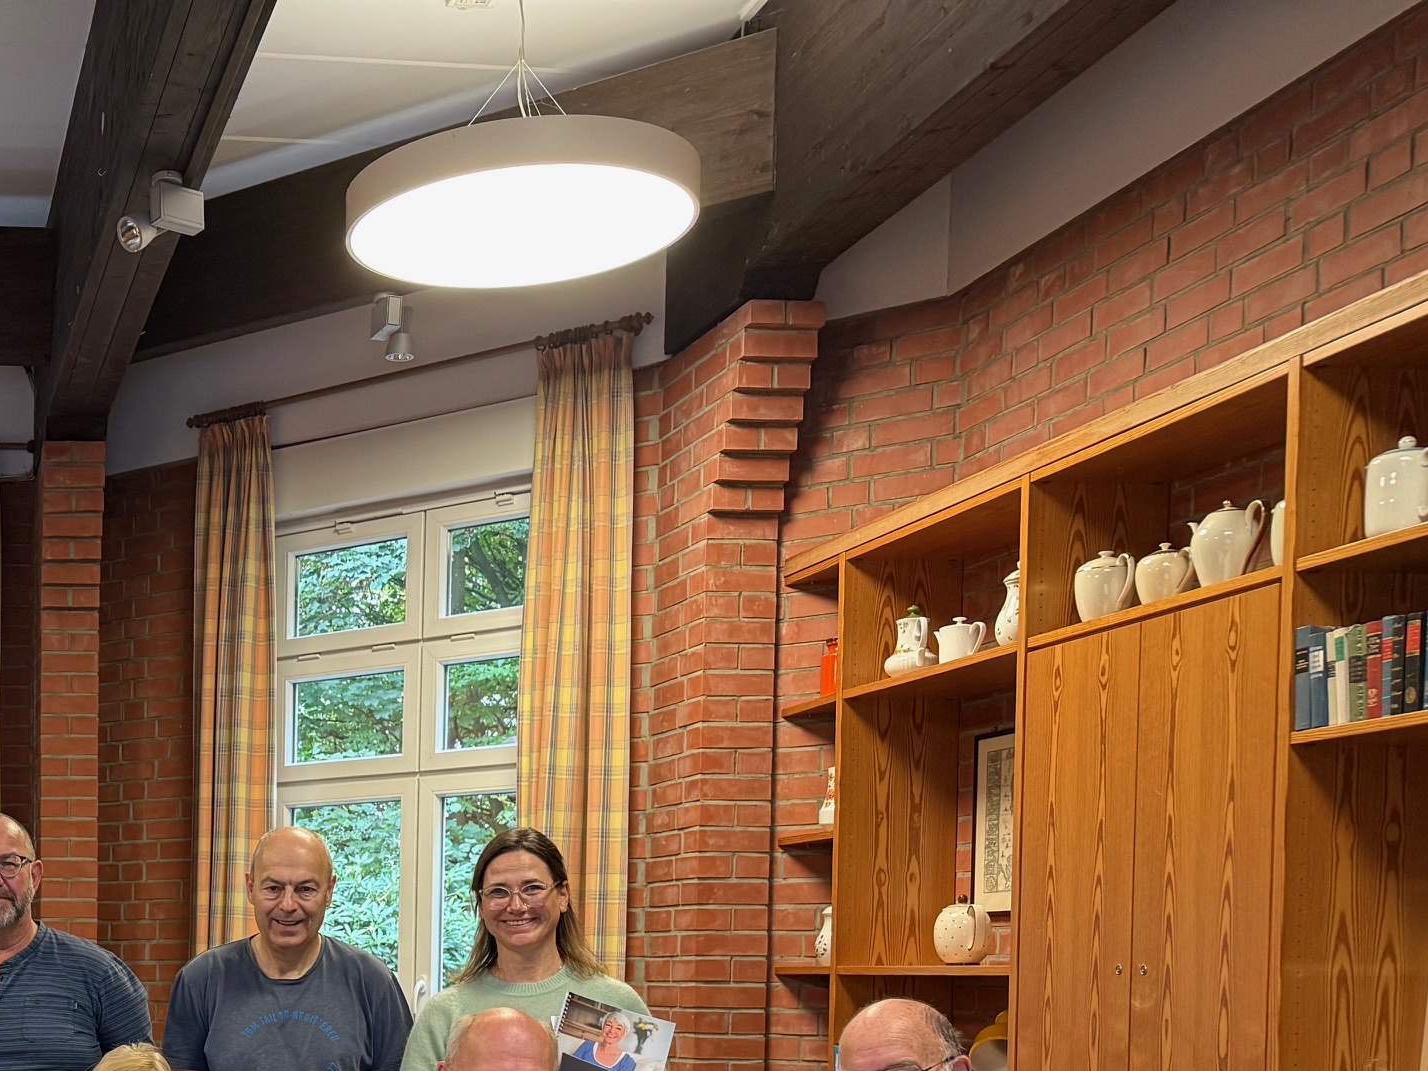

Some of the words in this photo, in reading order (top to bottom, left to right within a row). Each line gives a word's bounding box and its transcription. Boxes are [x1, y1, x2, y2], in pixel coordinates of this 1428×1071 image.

[241, 1022, 259, 1038] TOM
[260, 1010, 289, 1025] TAILOR
[292, 1011, 339, 1041] REGISTERED
